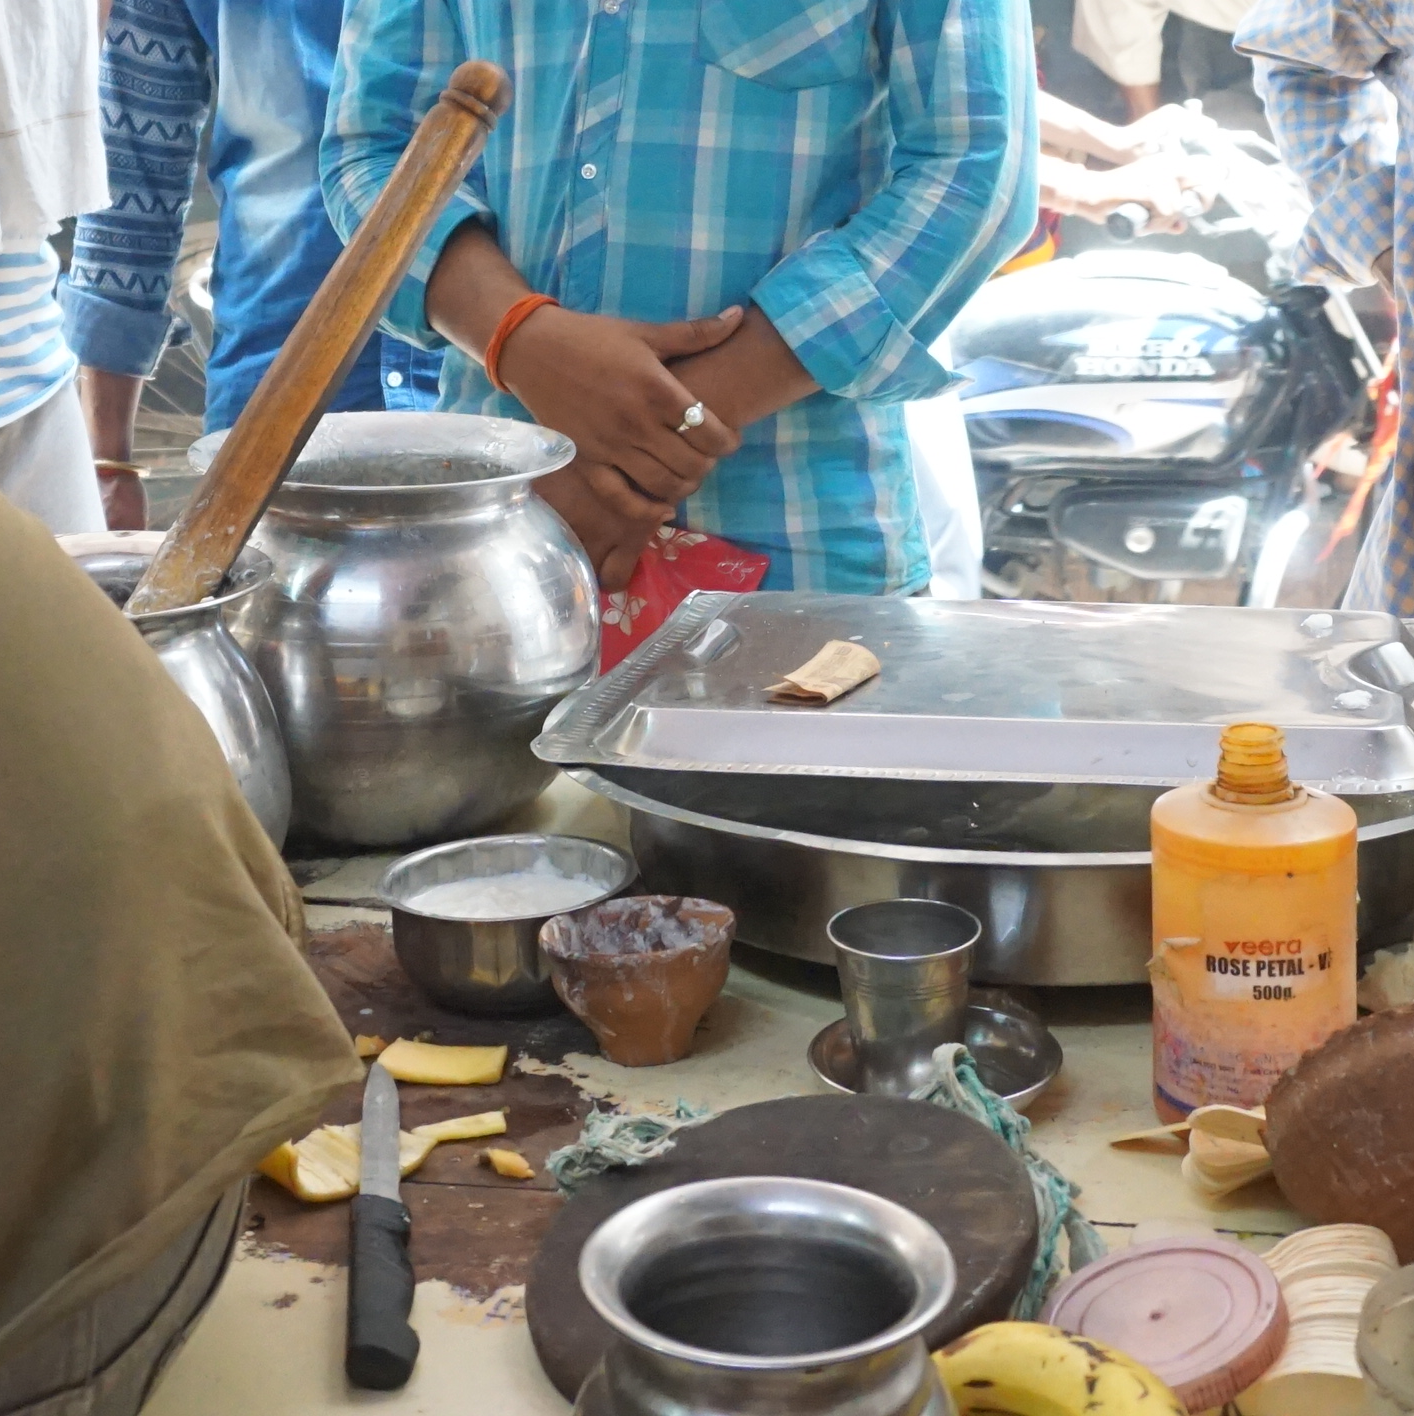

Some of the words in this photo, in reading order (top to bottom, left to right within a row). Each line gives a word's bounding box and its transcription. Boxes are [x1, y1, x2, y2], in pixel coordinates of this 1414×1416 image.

[1074, 356, 1216, 376] HONDA
[1224, 939, 1301, 955] veera
[1206, 954, 1250, 977] ROSE
[1256, 958, 1305, 977] PETAL
